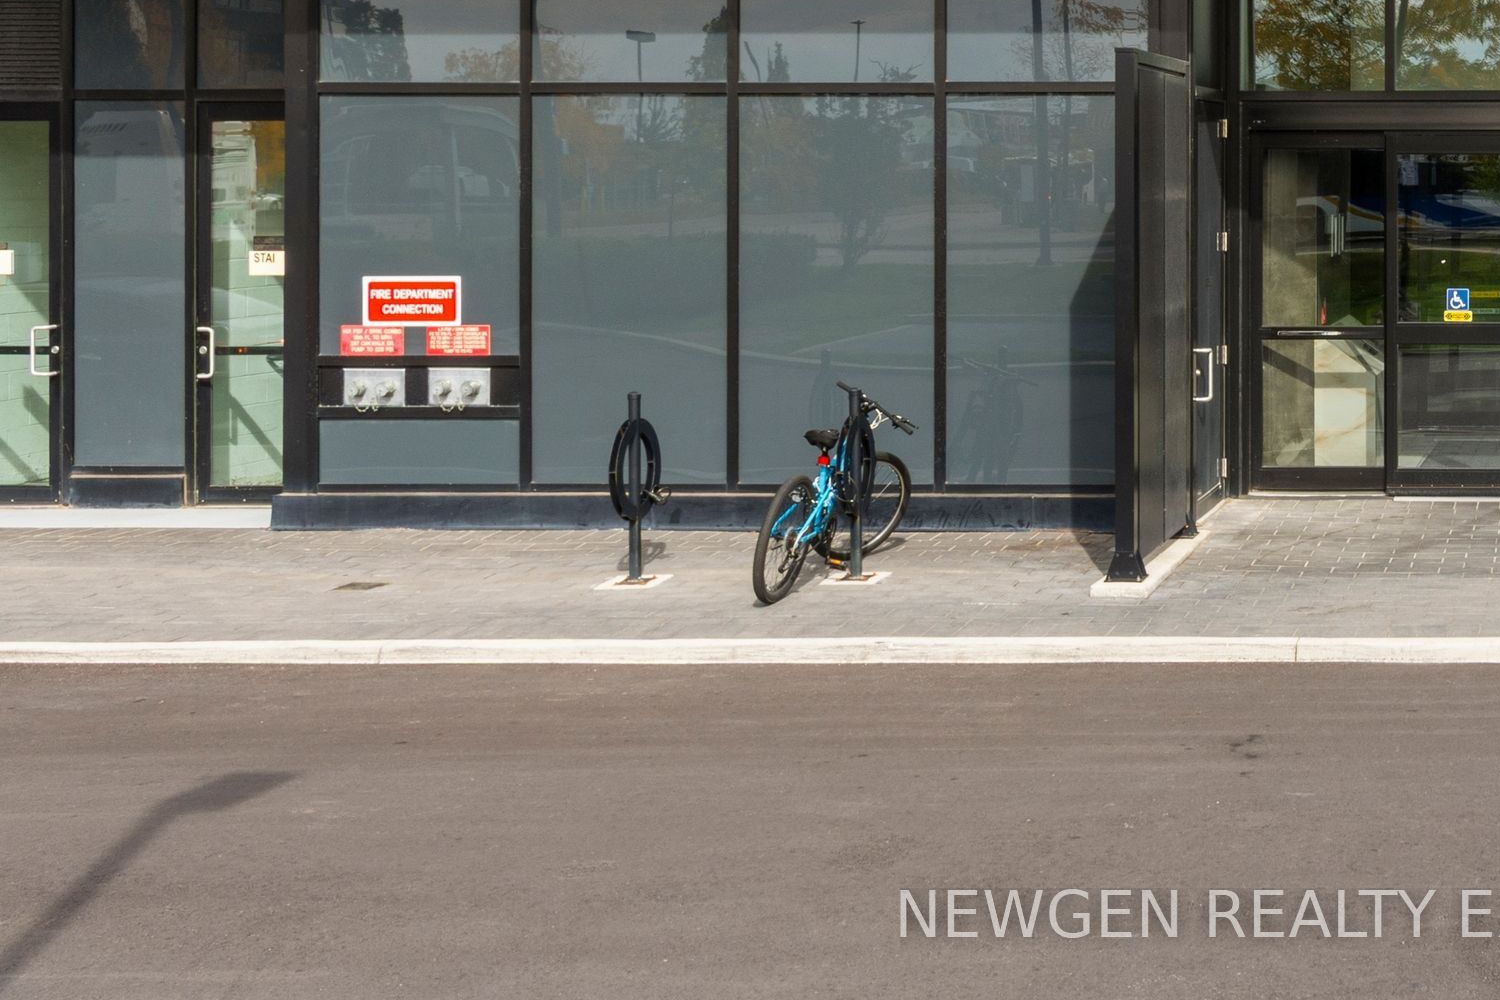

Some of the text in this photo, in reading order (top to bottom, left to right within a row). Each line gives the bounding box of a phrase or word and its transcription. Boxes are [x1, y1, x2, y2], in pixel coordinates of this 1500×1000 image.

[254, 252, 275, 263] STAI
[370, 288, 454, 300] FIRE DEPARTMENT
[381, 303, 444, 315] CONNECTION
